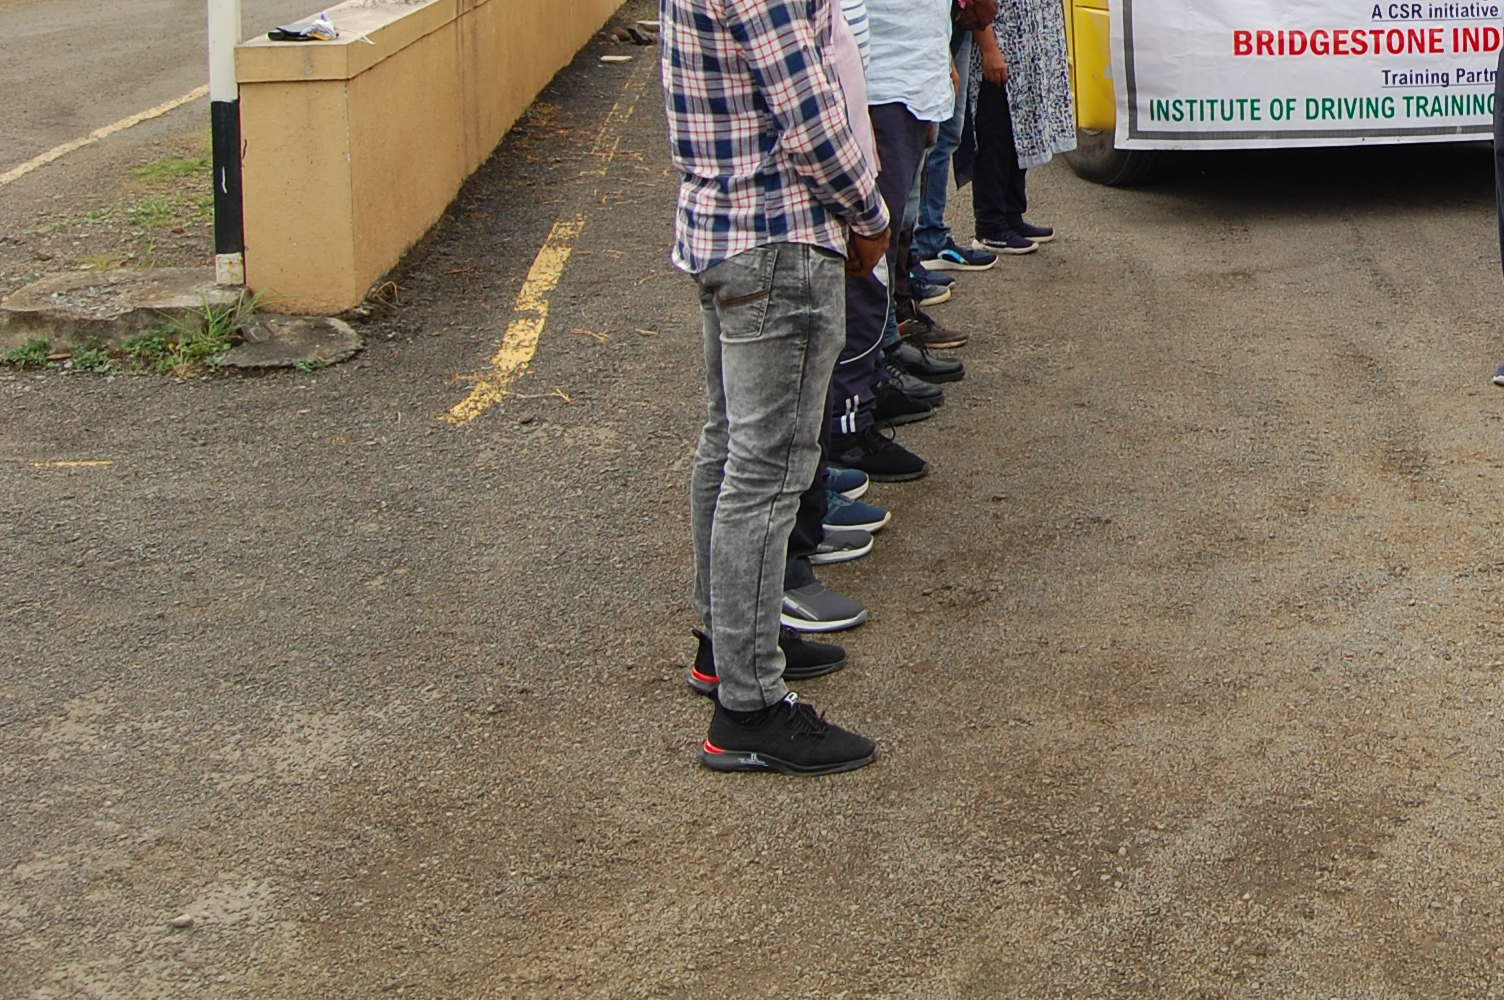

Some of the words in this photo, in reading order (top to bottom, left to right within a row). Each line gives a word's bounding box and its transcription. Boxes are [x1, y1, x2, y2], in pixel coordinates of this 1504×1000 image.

[1371, 4, 1383, 19] A
[1388, 3, 1422, 19] CSR
[1429, 2, 1498, 18] initiative
[1233, 28, 1445, 56] BRIDGESTONE
[1382, 68, 1450, 87] Training
[1150, 97, 1261, 122] INSTITUTE
[1269, 97, 1296, 121] OF
[1305, 96, 1395, 120] DRIVING
